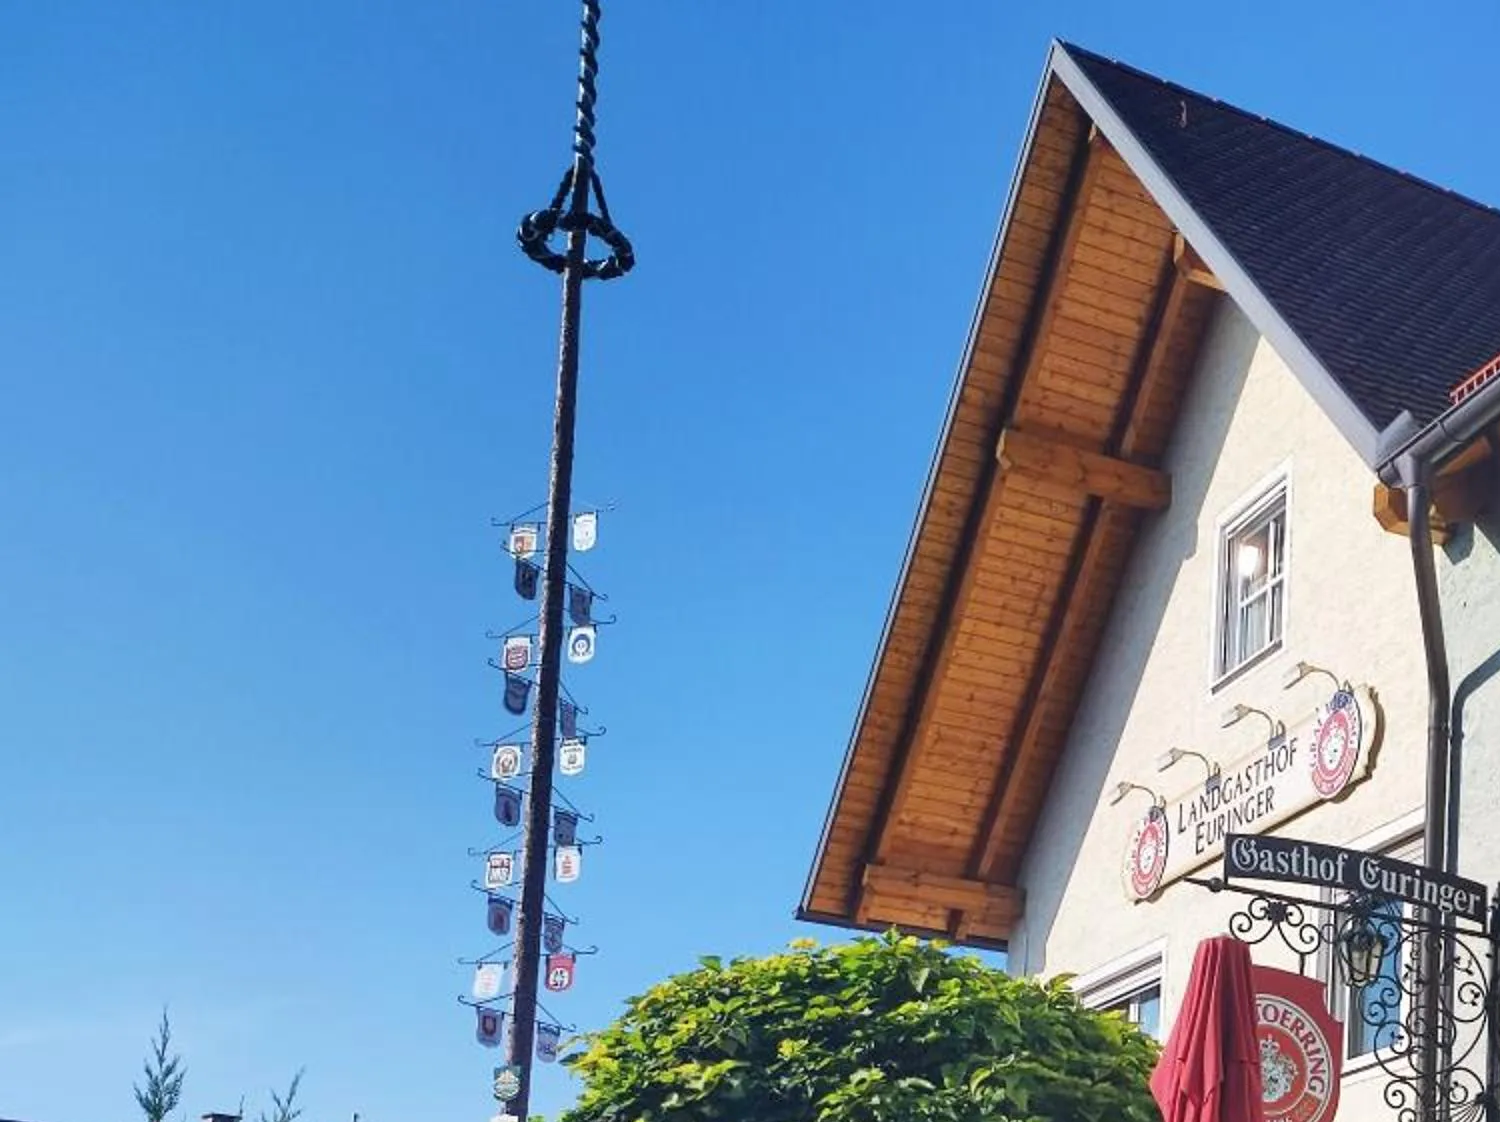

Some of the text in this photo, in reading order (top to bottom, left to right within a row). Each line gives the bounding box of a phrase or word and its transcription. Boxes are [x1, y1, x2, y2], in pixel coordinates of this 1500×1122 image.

[1177, 737, 1298, 834] LANDGASTHOF
[1195, 785, 1275, 855] EURINGER
[1231, 837, 1481, 915] Gasthof Euringer
